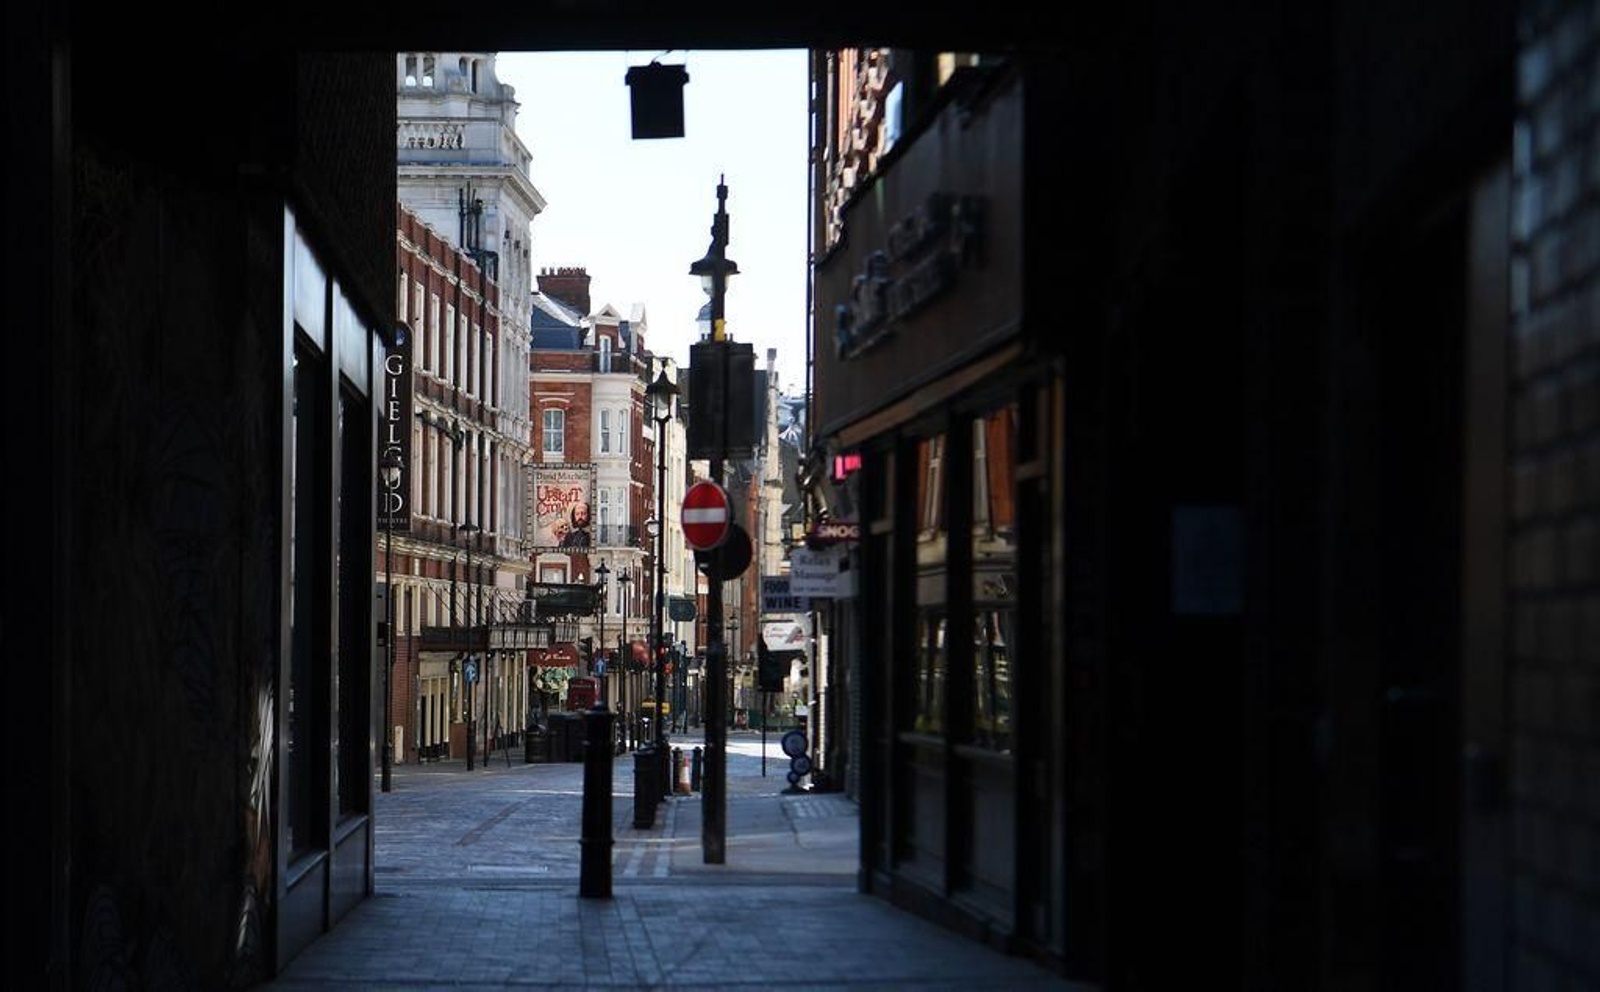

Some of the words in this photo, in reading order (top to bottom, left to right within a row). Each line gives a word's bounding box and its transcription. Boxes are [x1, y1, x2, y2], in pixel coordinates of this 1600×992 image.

[818, 524, 860, 539] SNOG
[763, 581, 790, 593] FOOD
[764, 597, 801, 609] WINE
